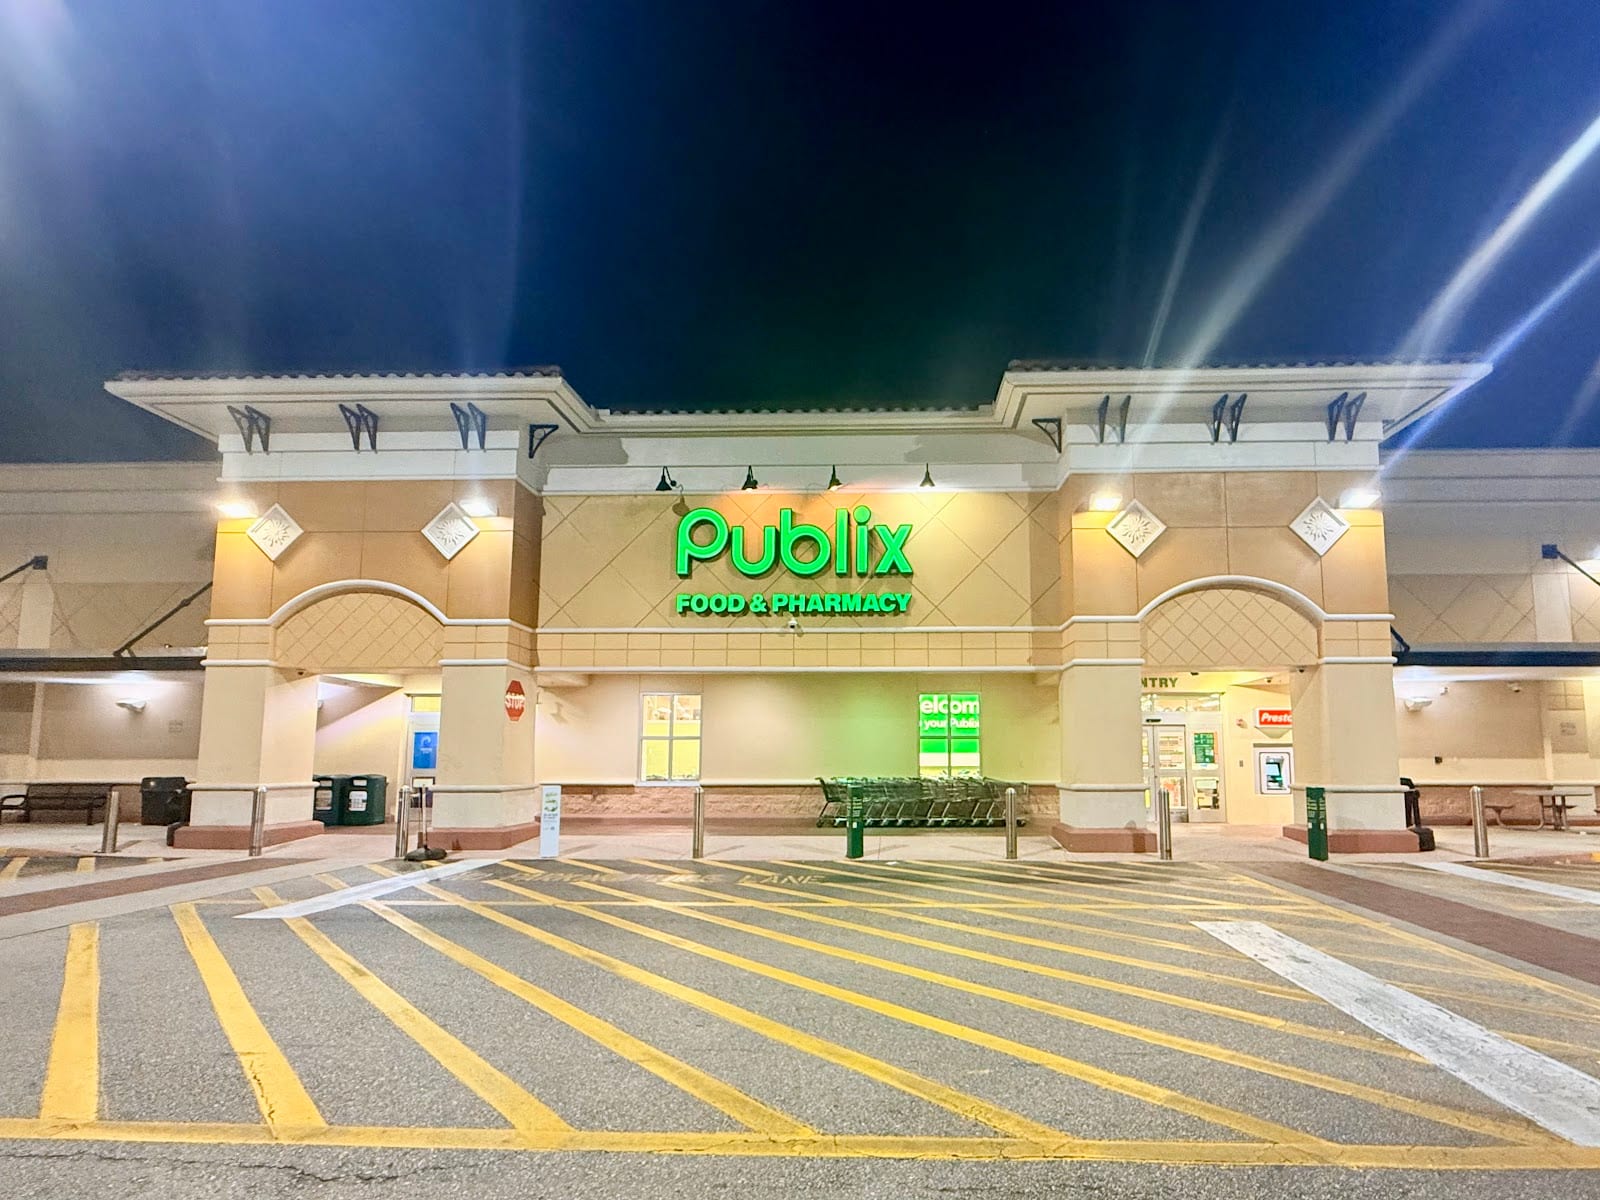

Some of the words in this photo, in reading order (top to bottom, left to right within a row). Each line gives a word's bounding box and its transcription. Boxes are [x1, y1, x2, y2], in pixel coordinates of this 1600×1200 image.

[676, 505, 913, 576] Publix
[676, 593, 746, 613] FOOD
[749, 593, 767, 613] &
[771, 593, 912, 613] PHARMACY
[1140, 677, 1178, 688] NTRY
[505, 693, 525, 709] STOP
[919, 694, 979, 714] elcom
[738, 874, 825, 886] LANE
